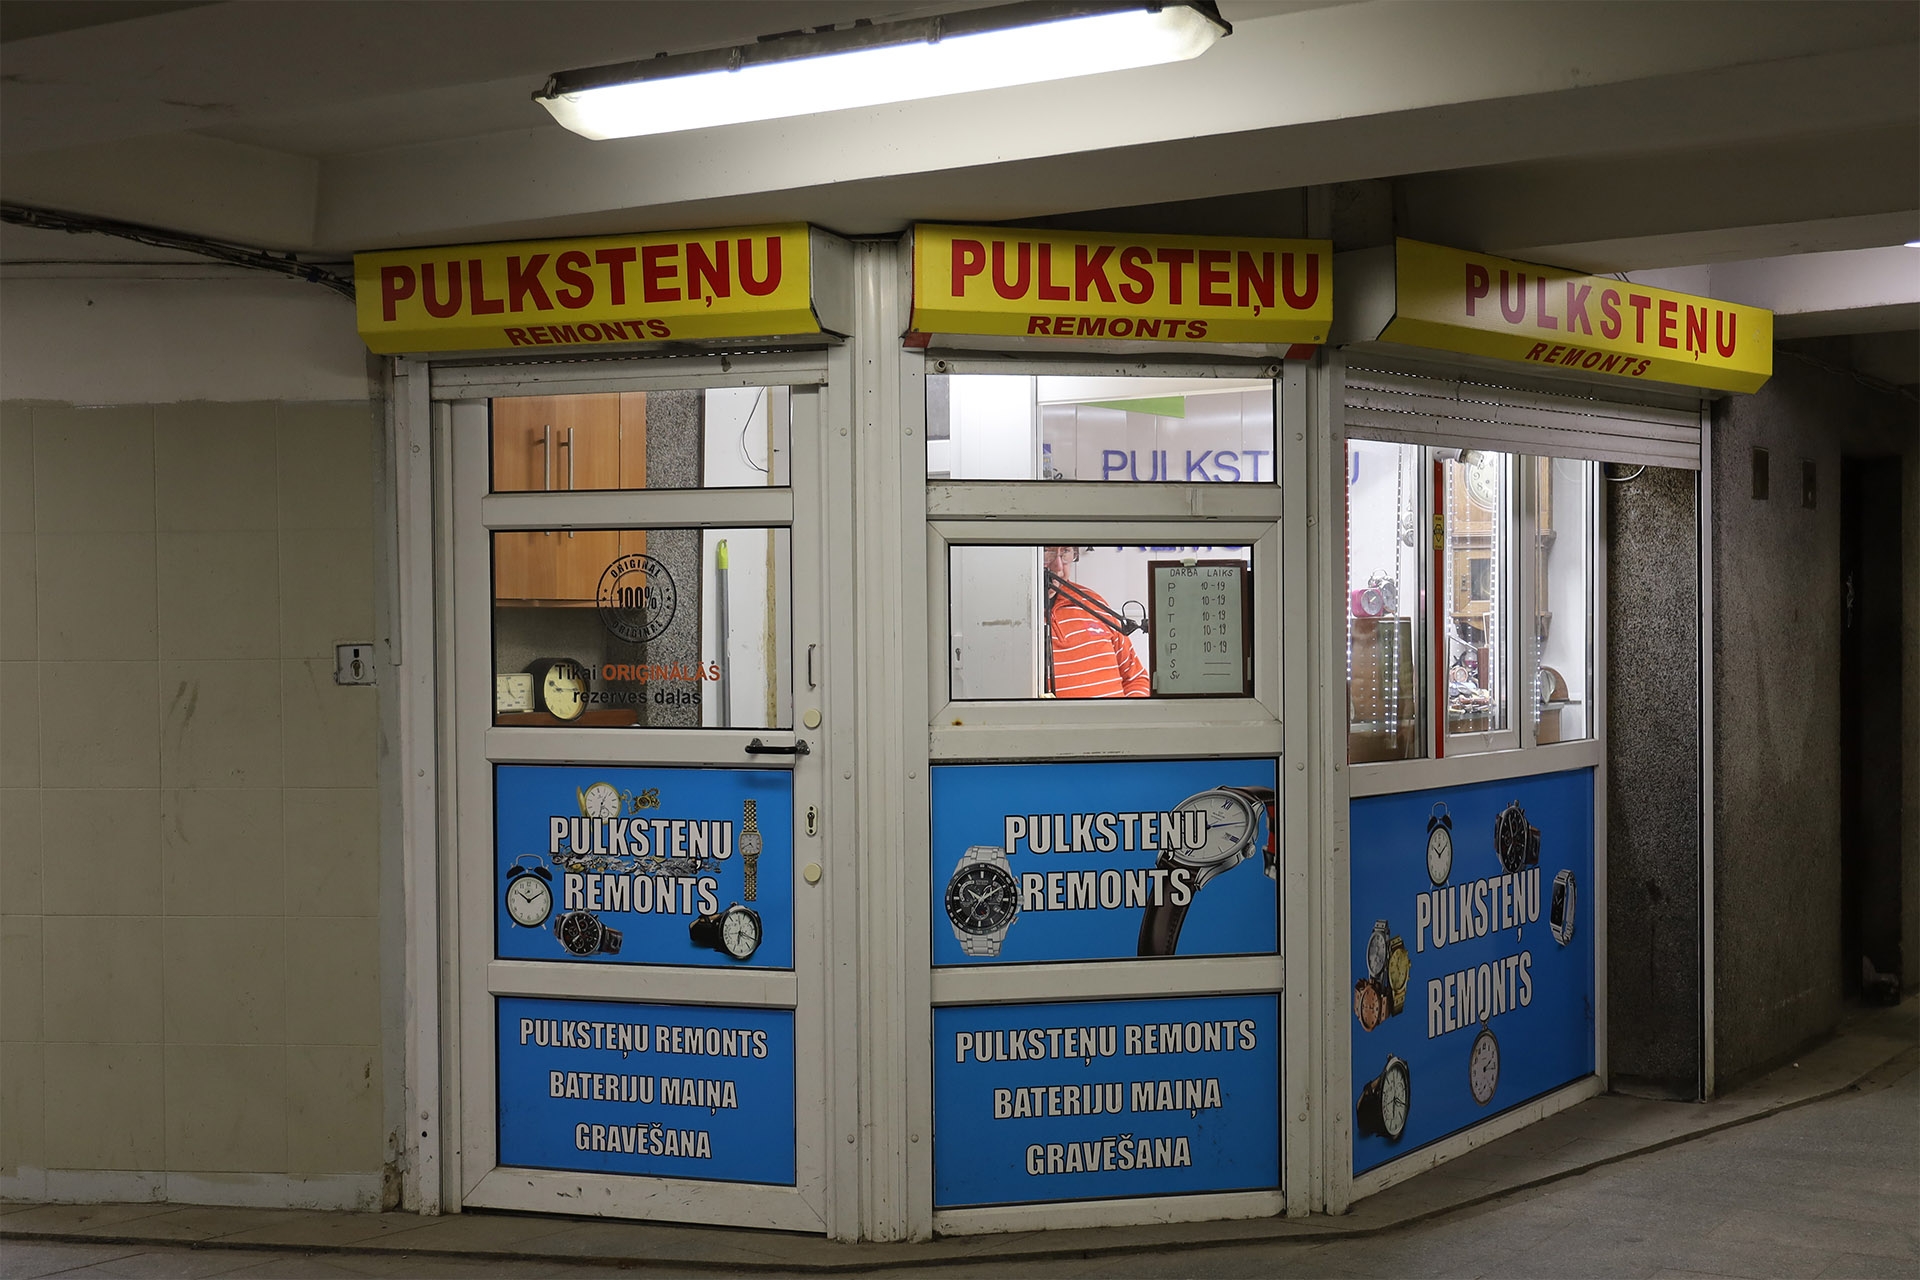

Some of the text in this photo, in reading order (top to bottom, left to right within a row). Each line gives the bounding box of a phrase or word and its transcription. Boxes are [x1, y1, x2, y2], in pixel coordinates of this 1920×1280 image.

[380, 236, 782, 321] PULKSTEŅU
[951, 239, 1319, 317] PULKSTEŅU
[1027, 315, 1208, 339] REMONTS
[1465, 262, 1737, 361] PULKSTEŅU
[504, 319, 671, 346] REMONTS
[1525, 342, 1652, 377] REMONTS
[610, 559, 661, 578] ORIGINAL
[1170, 569, 1233, 577] DARBA LAIKS
[617, 586, 657, 610] 100%
[1168, 583, 1176, 592] P
[612, 620, 663, 638] ORIGINAL
[1168, 614, 1175, 623] T
[1169, 643, 1178, 653] P
[555, 664, 596, 681] Tikai
[573, 688, 702, 708] rezerves daļas
[564, 872, 718, 916] REMONTS
[1021, 868, 1193, 912] REMONTS
[1416, 866, 1541, 952] PULKSTEŅU
[1427, 950, 1533, 1039] REMONTS
[520, 1018, 768, 1059] PULKSTEŅU REMONTS
[955, 1018, 1257, 1067] PULKSTEŅU REMONTS
[549, 1070, 738, 1115] BATERIJU MAIŅA
[993, 1077, 1222, 1120] BATERIJU MAIŅA
[575, 1122, 712, 1159] GRAVĒŠANA
[1025, 1133, 1192, 1176] GRAVĒŠANA
